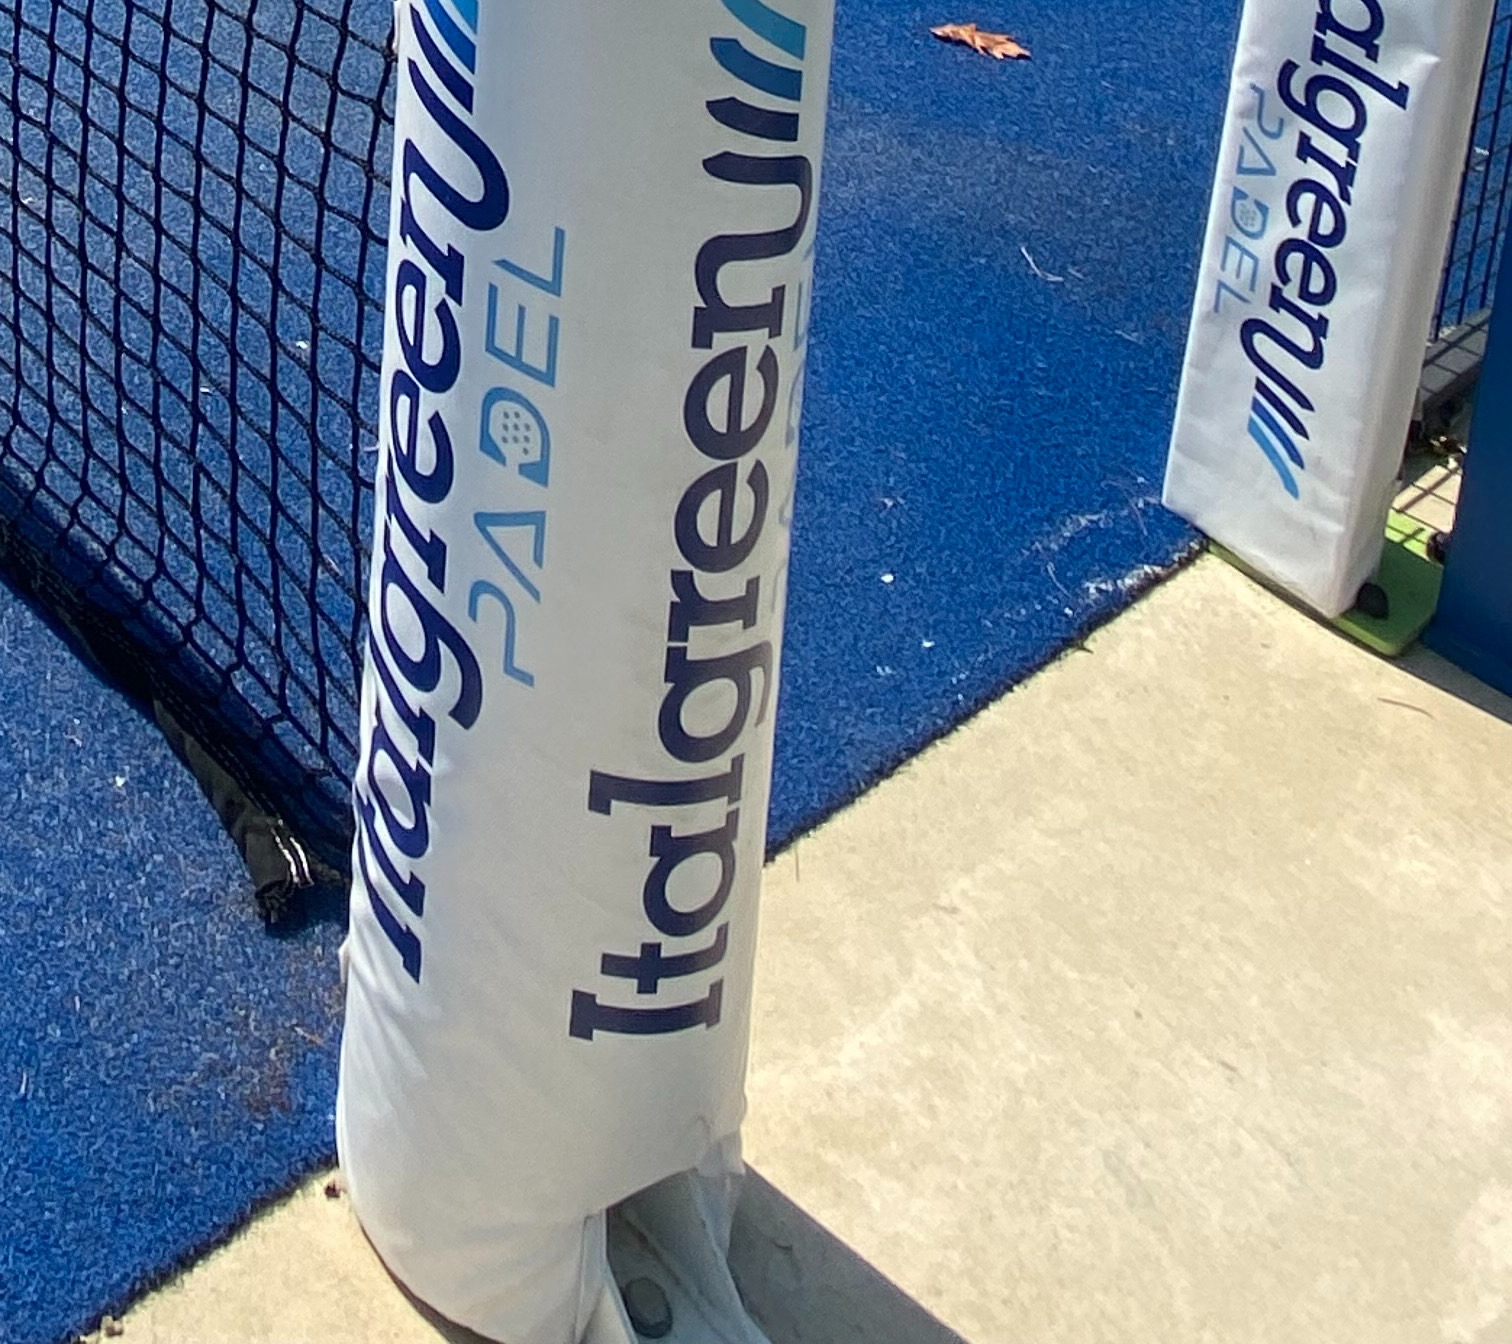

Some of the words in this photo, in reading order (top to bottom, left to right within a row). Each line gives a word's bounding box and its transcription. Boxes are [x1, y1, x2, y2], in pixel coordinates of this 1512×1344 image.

[353, 57, 510, 985] Italgreen
[467, 226, 566, 689] PADEL
[1214, 82, 1285, 314] PADEL
[569, 150, 813, 1042] Italgreen
